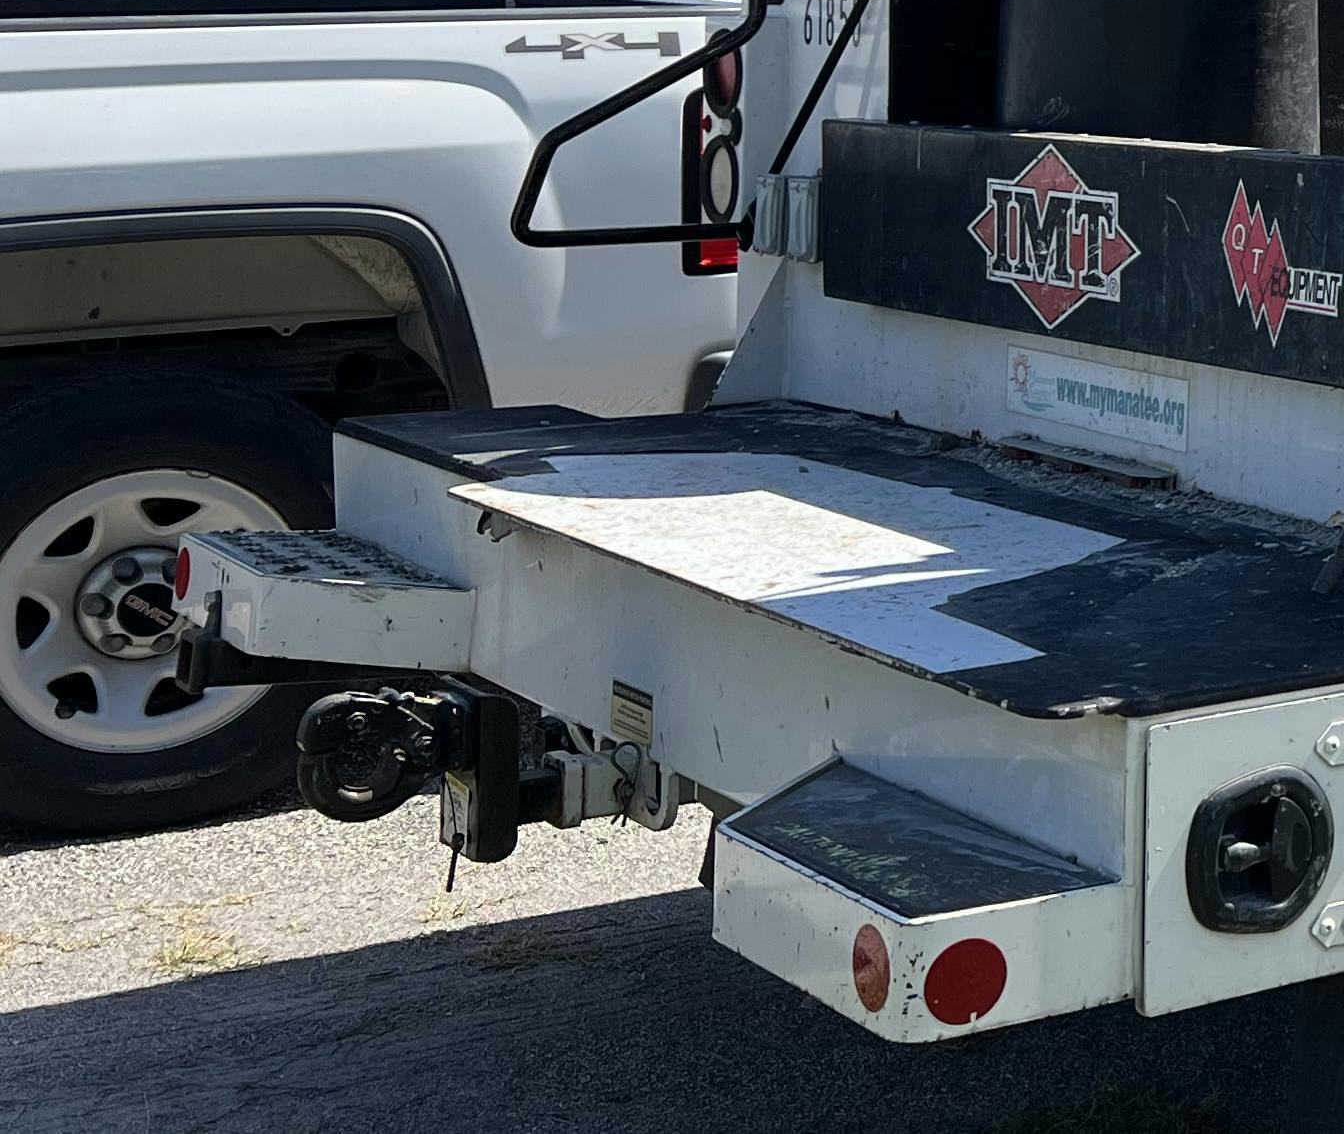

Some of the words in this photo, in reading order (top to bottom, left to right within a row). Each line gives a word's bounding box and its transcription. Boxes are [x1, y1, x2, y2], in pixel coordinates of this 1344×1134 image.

[988, 179, 1119, 296] IMT
[1231, 222, 1248, 252] Q
[1251, 247, 1265, 275] T
[1271, 266, 1341, 307] EQUIPMENT
[1056, 376, 1185, 435] www.mymanatee.org
[126, 594, 174, 627] GMC
